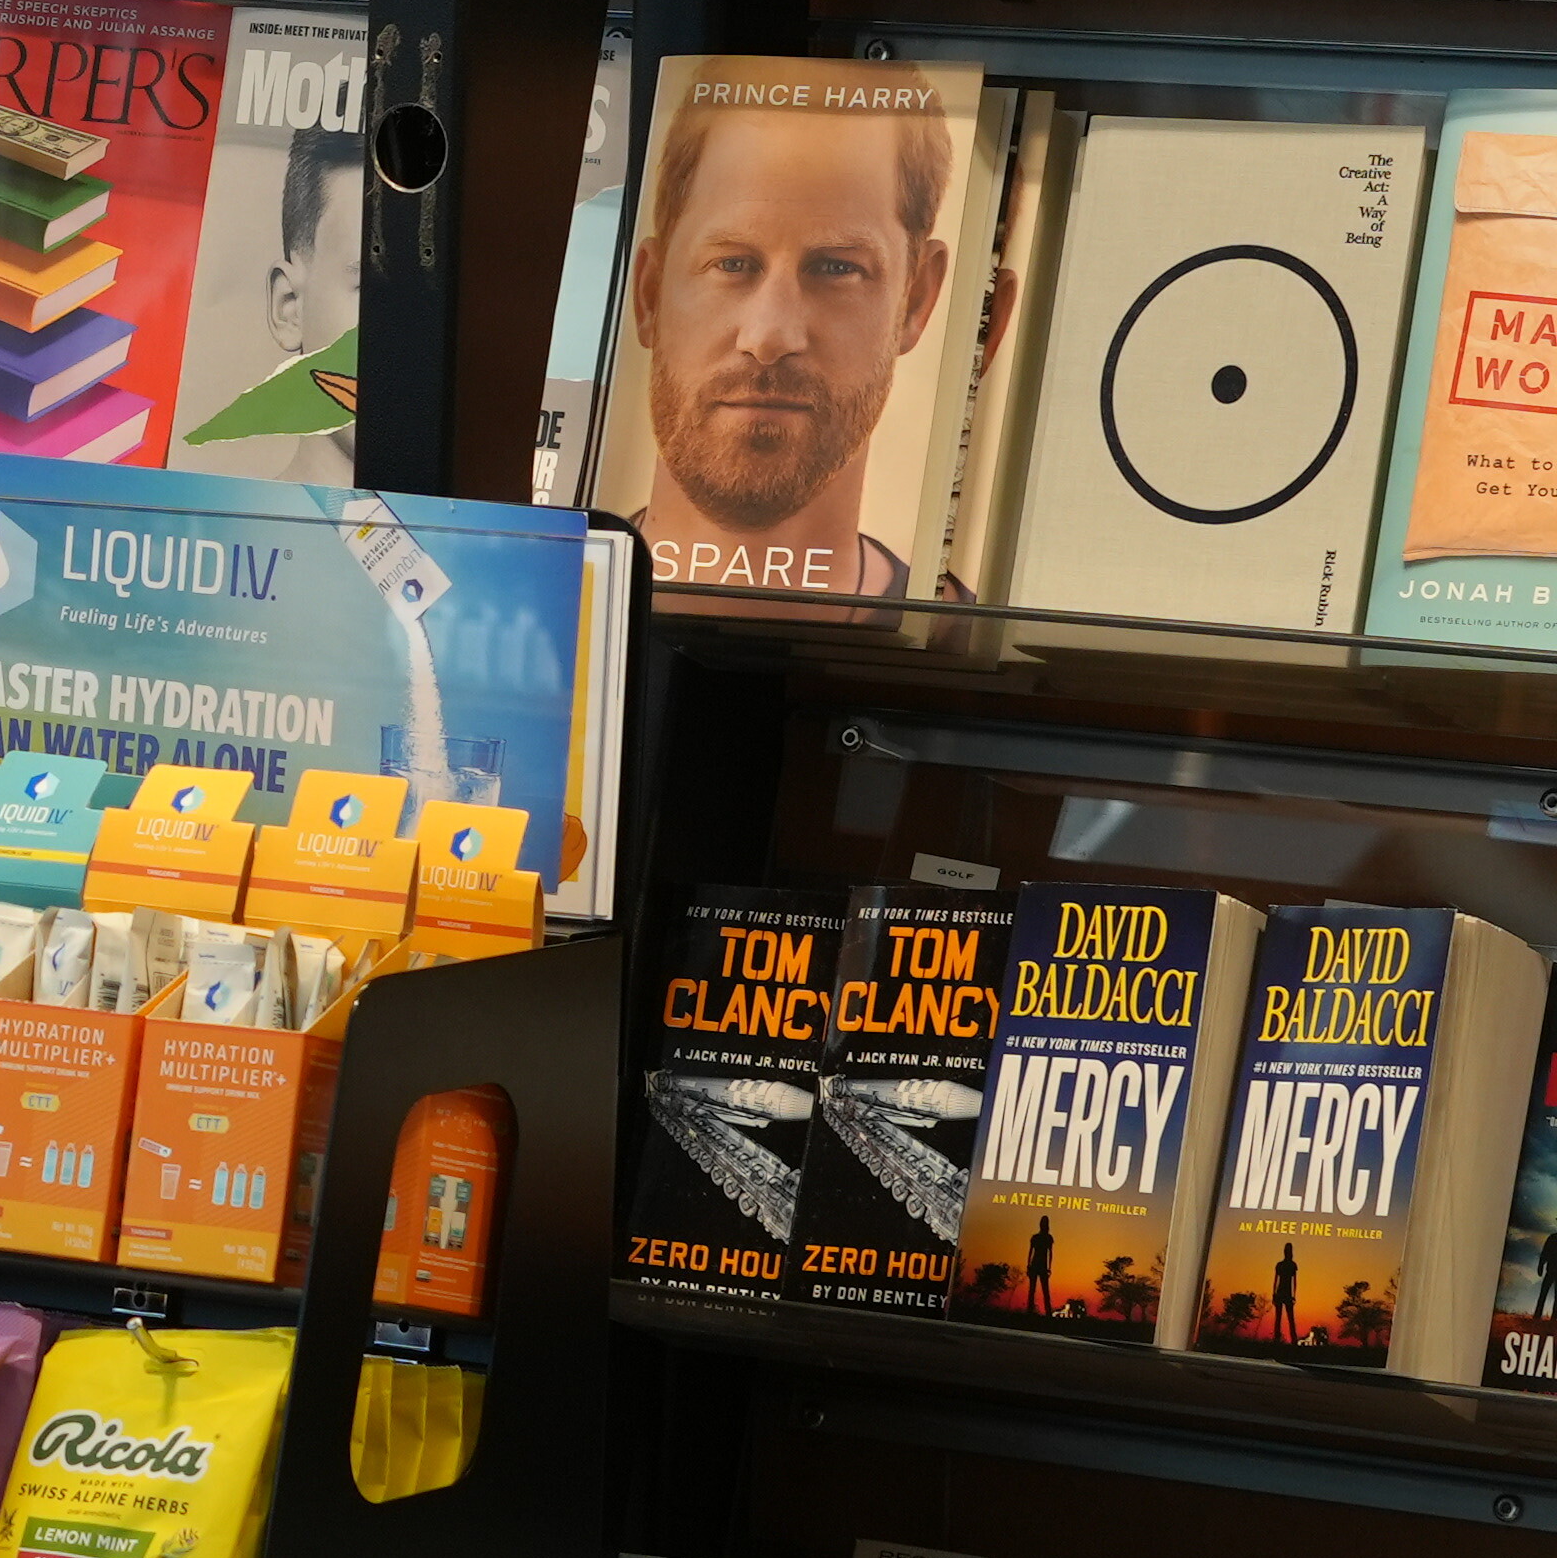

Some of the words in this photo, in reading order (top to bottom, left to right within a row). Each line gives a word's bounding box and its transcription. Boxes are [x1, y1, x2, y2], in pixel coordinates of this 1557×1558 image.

[693, 82, 809, 108] PRINCE
[824, 85, 933, 111] HARRY
[1339, 166, 1392, 179] Creative
[1368, 154, 1393, 166] The
[1363, 181, 1389, 193] Act:
[1376, 195, 1388, 205] A
[1358, 206, 1386, 221] Way
[1370, 220, 1386, 231] of
[1345, 232, 1383, 248] Being
[652, 542, 834, 590] SPARE
[1400, 580, 1514, 604] JONAH
[61, 606, 115, 630] Fueling
[124, 613, 172, 637] Life's
[177, 619, 268, 645] Adventures
[109, 672, 333, 745] HYDRATION
[937, 869, 975, 881] GOLF
[1054, 903, 1167, 963] DAVID
[720, 928, 813, 982] TOM
[1010, 961, 1197, 1028] BALDACCI
[982, 1055, 1185, 1195] MERCY
[35, 1526, 94, 1547] LEMON
[97, 1532, 139, 1553] MINT
